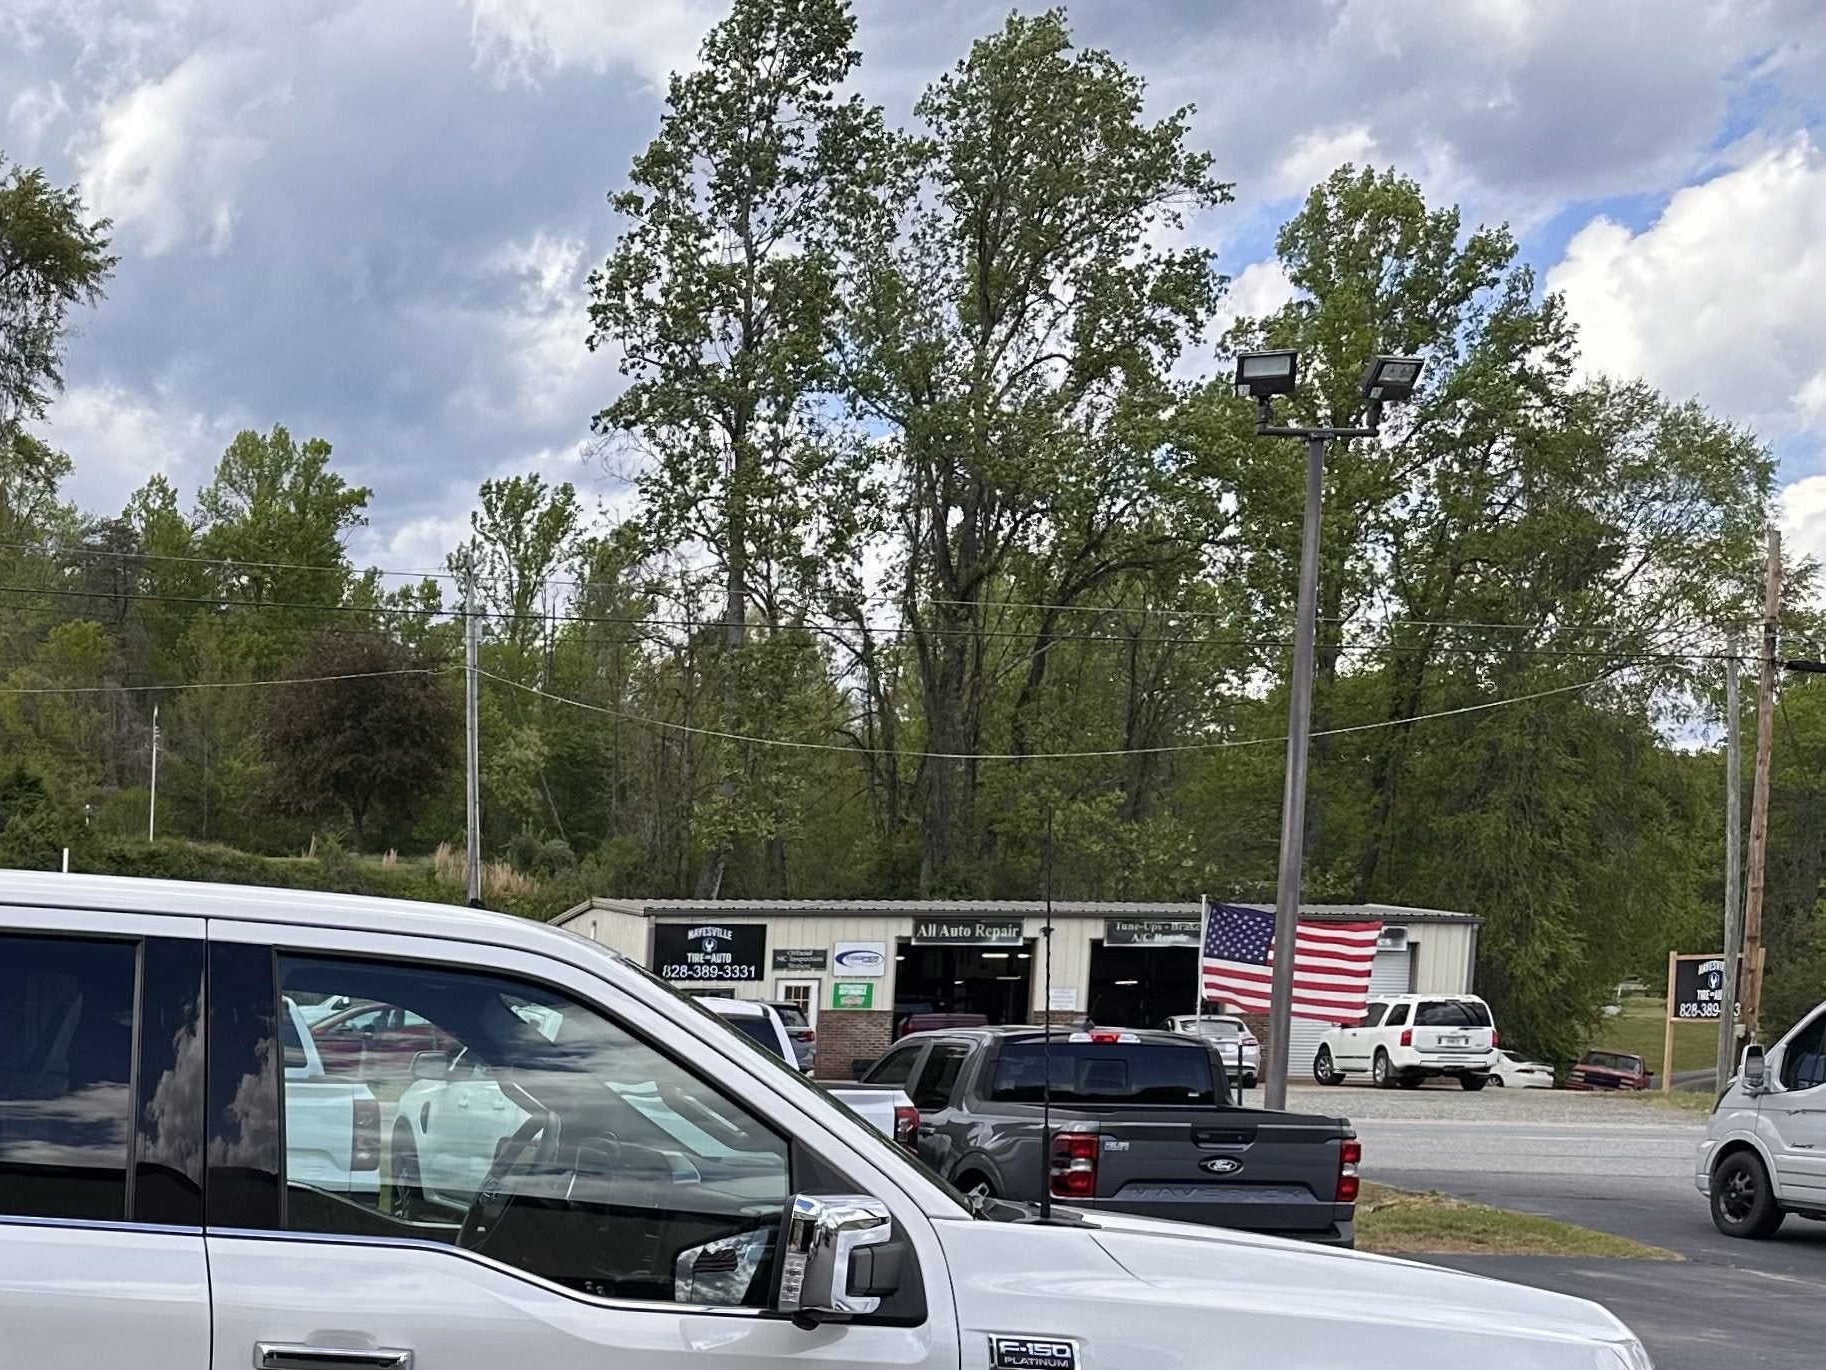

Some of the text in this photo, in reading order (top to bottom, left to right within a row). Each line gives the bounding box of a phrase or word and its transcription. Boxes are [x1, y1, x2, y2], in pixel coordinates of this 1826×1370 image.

[916, 923, 1019, 941] All Auto Repair
[1170, 922, 1201, 931] Brake
[687, 953, 705, 963] TIRE
[710, 953, 732, 963] AUTO
[662, 965, 756, 978] 828-389-3331
[999, 1341, 1072, 1358] F-150
[1004, 1356, 1069, 1367] PLATINUM
